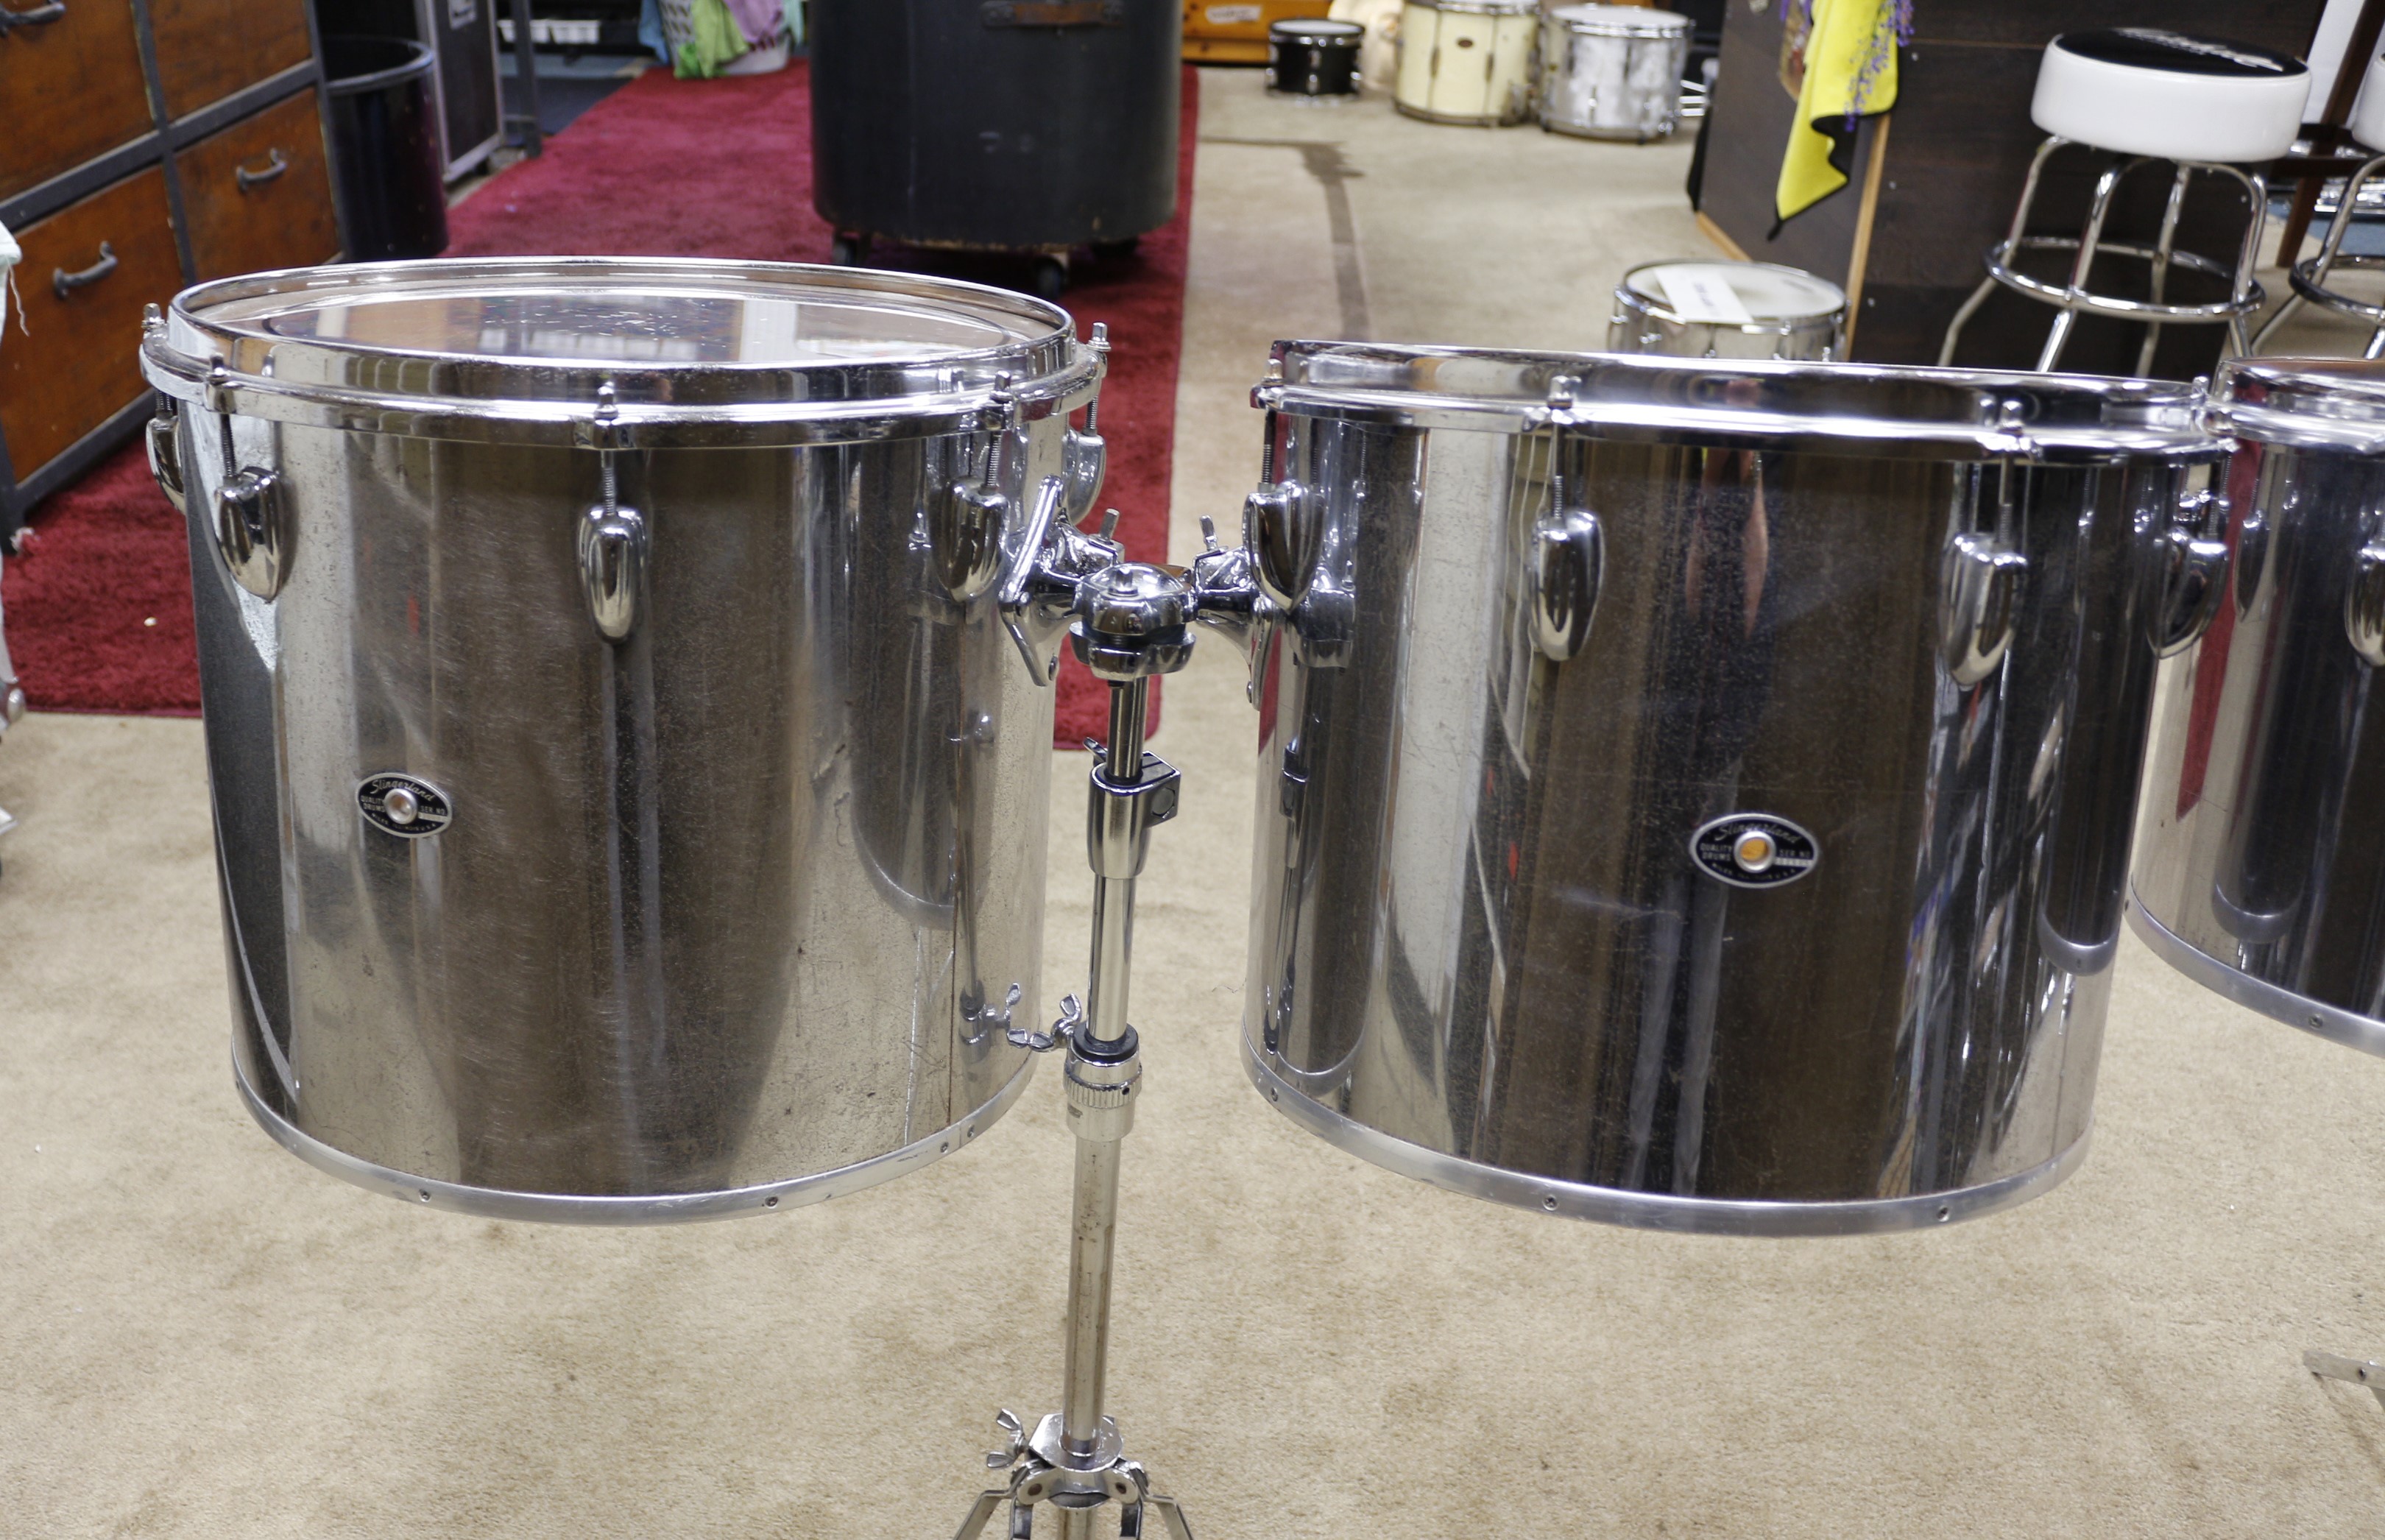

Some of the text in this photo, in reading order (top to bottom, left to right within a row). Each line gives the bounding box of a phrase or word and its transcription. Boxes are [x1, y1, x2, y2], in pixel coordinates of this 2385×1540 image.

[370, 780, 434, 801] Slingerland
[361, 795, 384, 805] QUALITY
[363, 802, 385, 812] DRUMS
[1714, 822, 1801, 844] Slingerland
[1700, 842, 1732, 852] QUALITY
[1701, 852, 1732, 861] DRUMS
